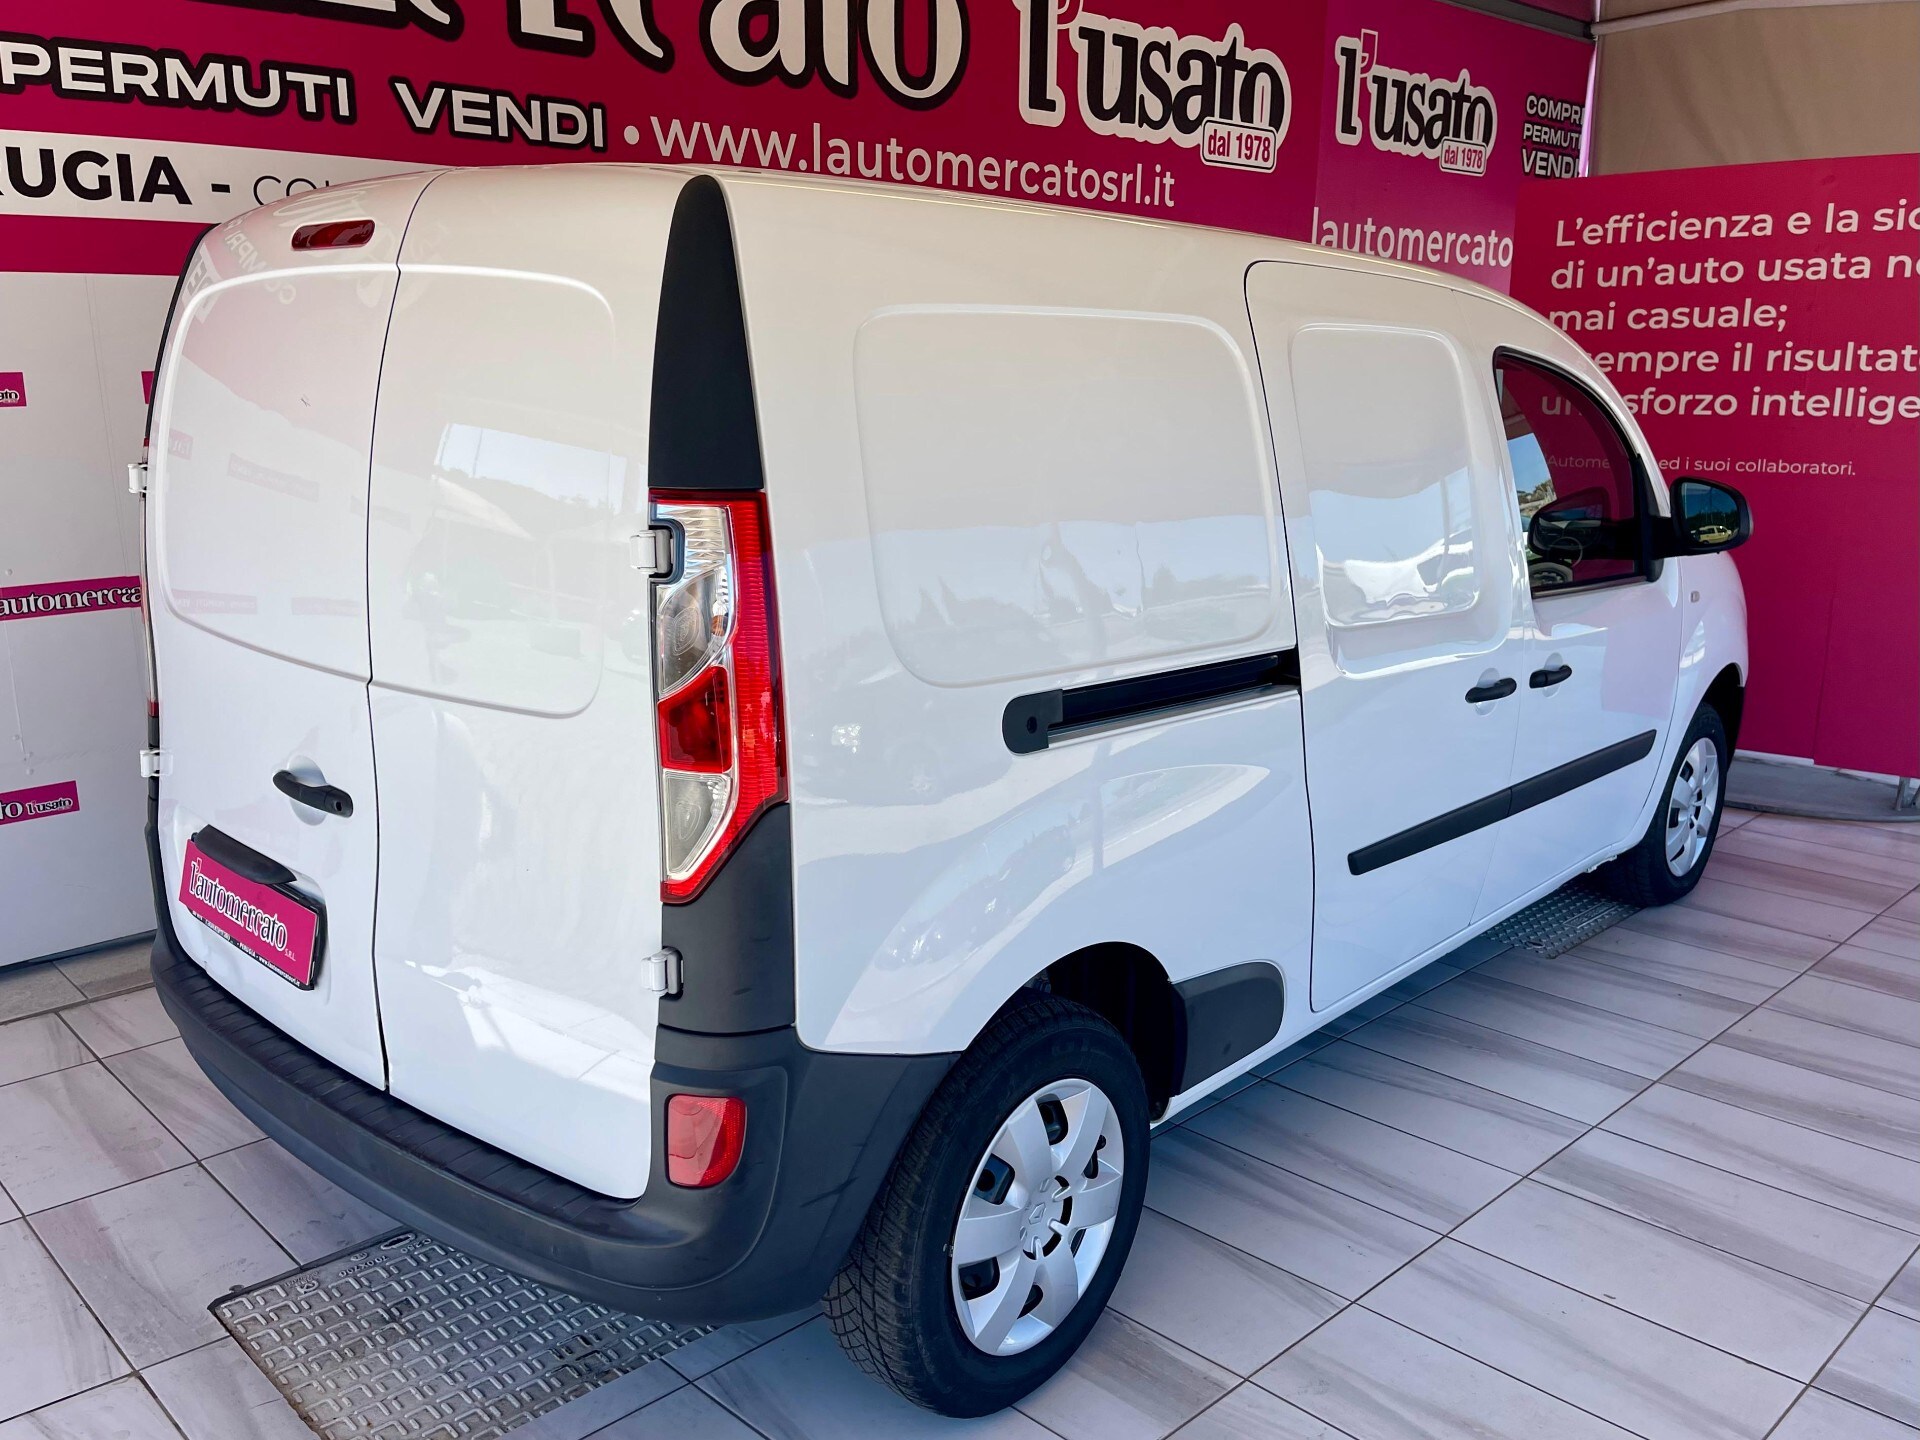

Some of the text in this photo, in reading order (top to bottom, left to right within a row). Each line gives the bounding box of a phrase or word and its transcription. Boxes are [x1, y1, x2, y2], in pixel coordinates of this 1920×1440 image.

[1336, 29, 1496, 156] l'usato
[0, 41, 1176, 207] PERMUTI VENDI www.lautomercatosrl.it
[1207, 129, 1271, 163] dal 1978
[1443, 147, 1483, 169] dal 1978
[0, 146, 193, 206] UGIA
[1311, 206, 1514, 267] lautomercato
[1787, 211, 1811, 235] e
[1825, 202, 1859, 233] la
[1551, 260, 1585, 290] di
[1758, 253, 1871, 281] usata
[1550, 298, 1788, 332] mai casuale;
[1590, 341, 1920, 379] empre il risultat
[1622, 387, 1738, 416] sforzo
[1658, 457, 1680, 470] ed
[1685, 457, 1690, 470] i
[1694, 458, 1731, 472] suoi
[1736, 459, 1856, 476] collaboratori.
[189, 857, 288, 952] l'automercato
